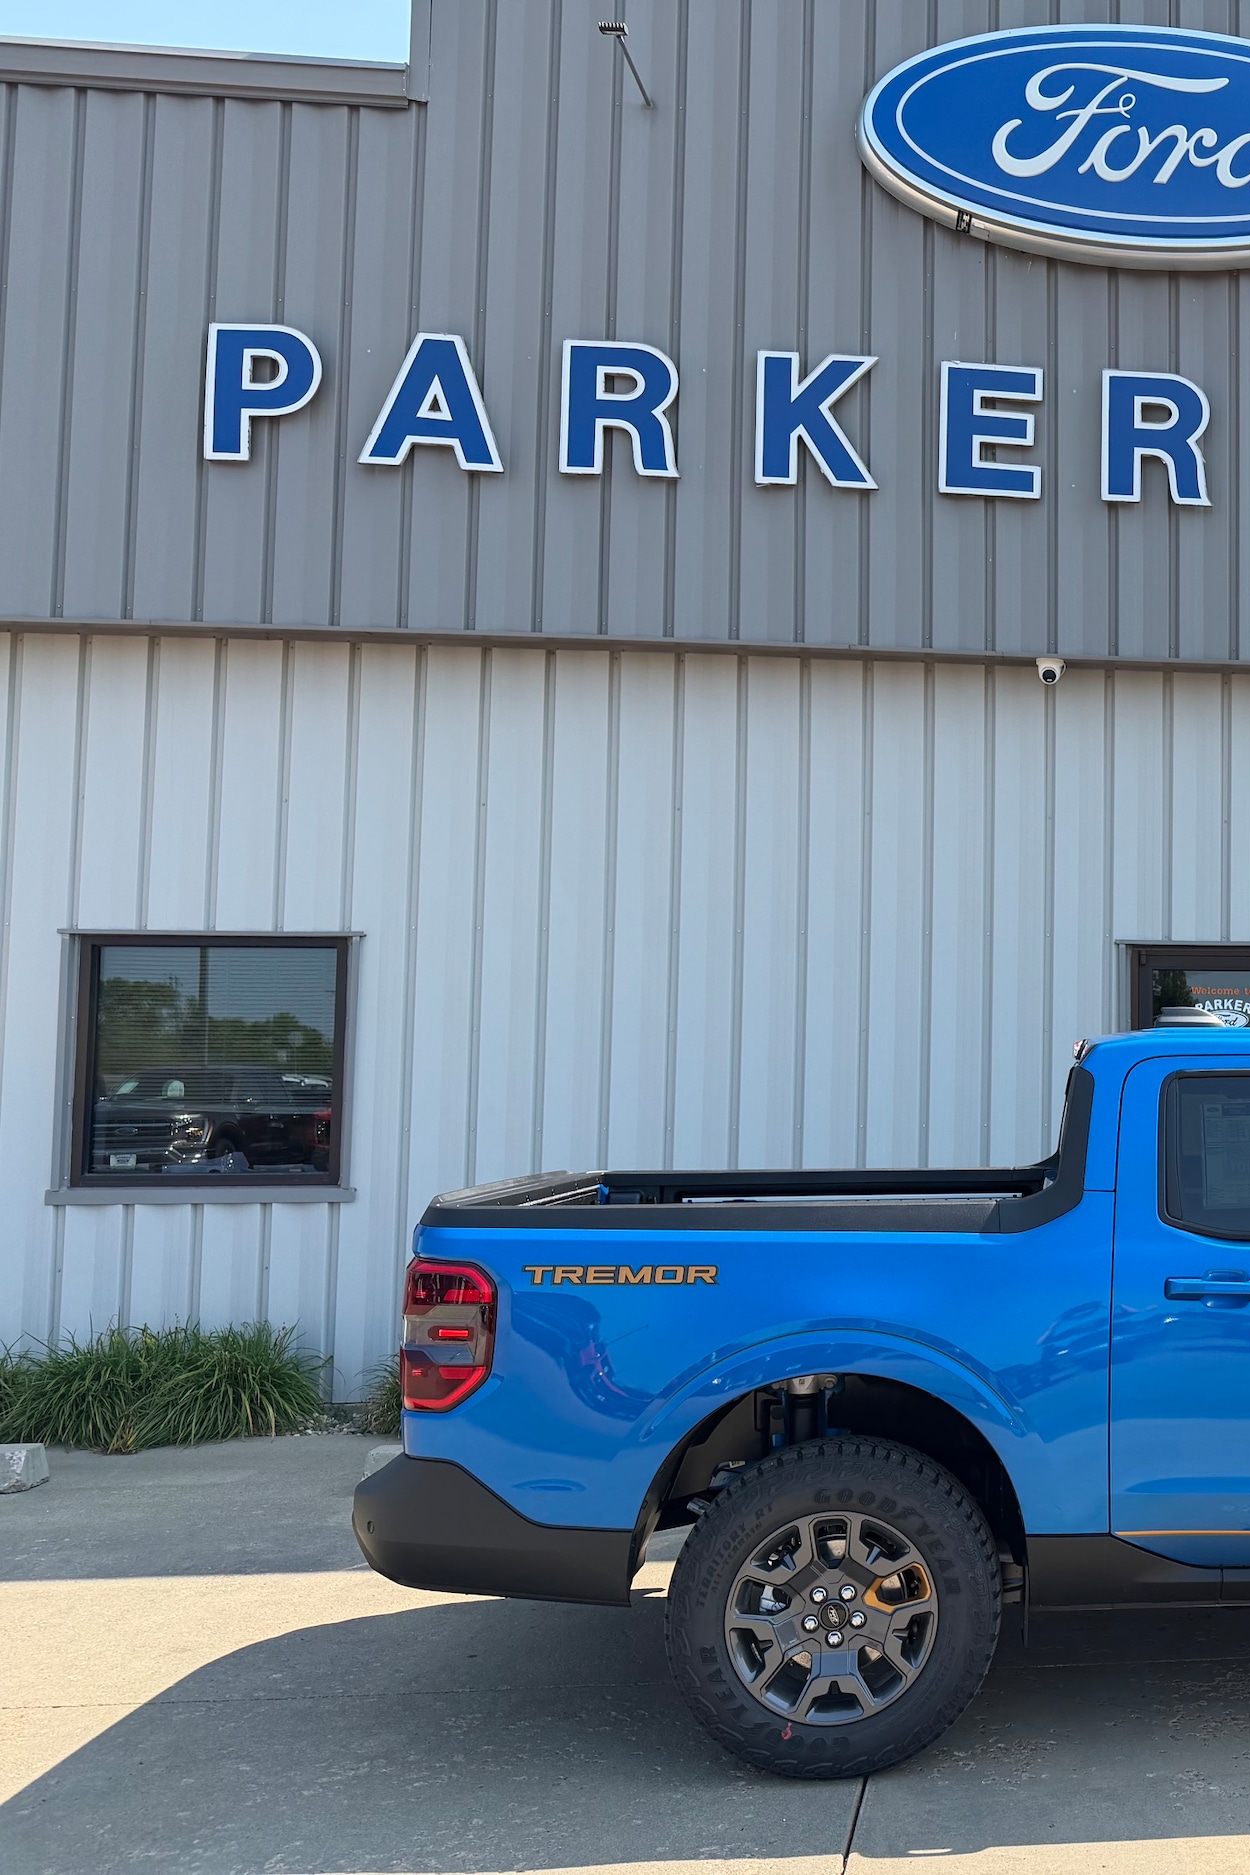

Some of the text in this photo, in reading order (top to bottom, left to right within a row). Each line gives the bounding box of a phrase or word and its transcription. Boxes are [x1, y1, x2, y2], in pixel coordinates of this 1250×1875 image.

[203, 321, 1213, 506] PARKER
[1191, 986, 1240, 995] Welcome
[523, 1265, 719, 1286] TREMOR
[696, 1522, 746, 1607] TERRITORY
